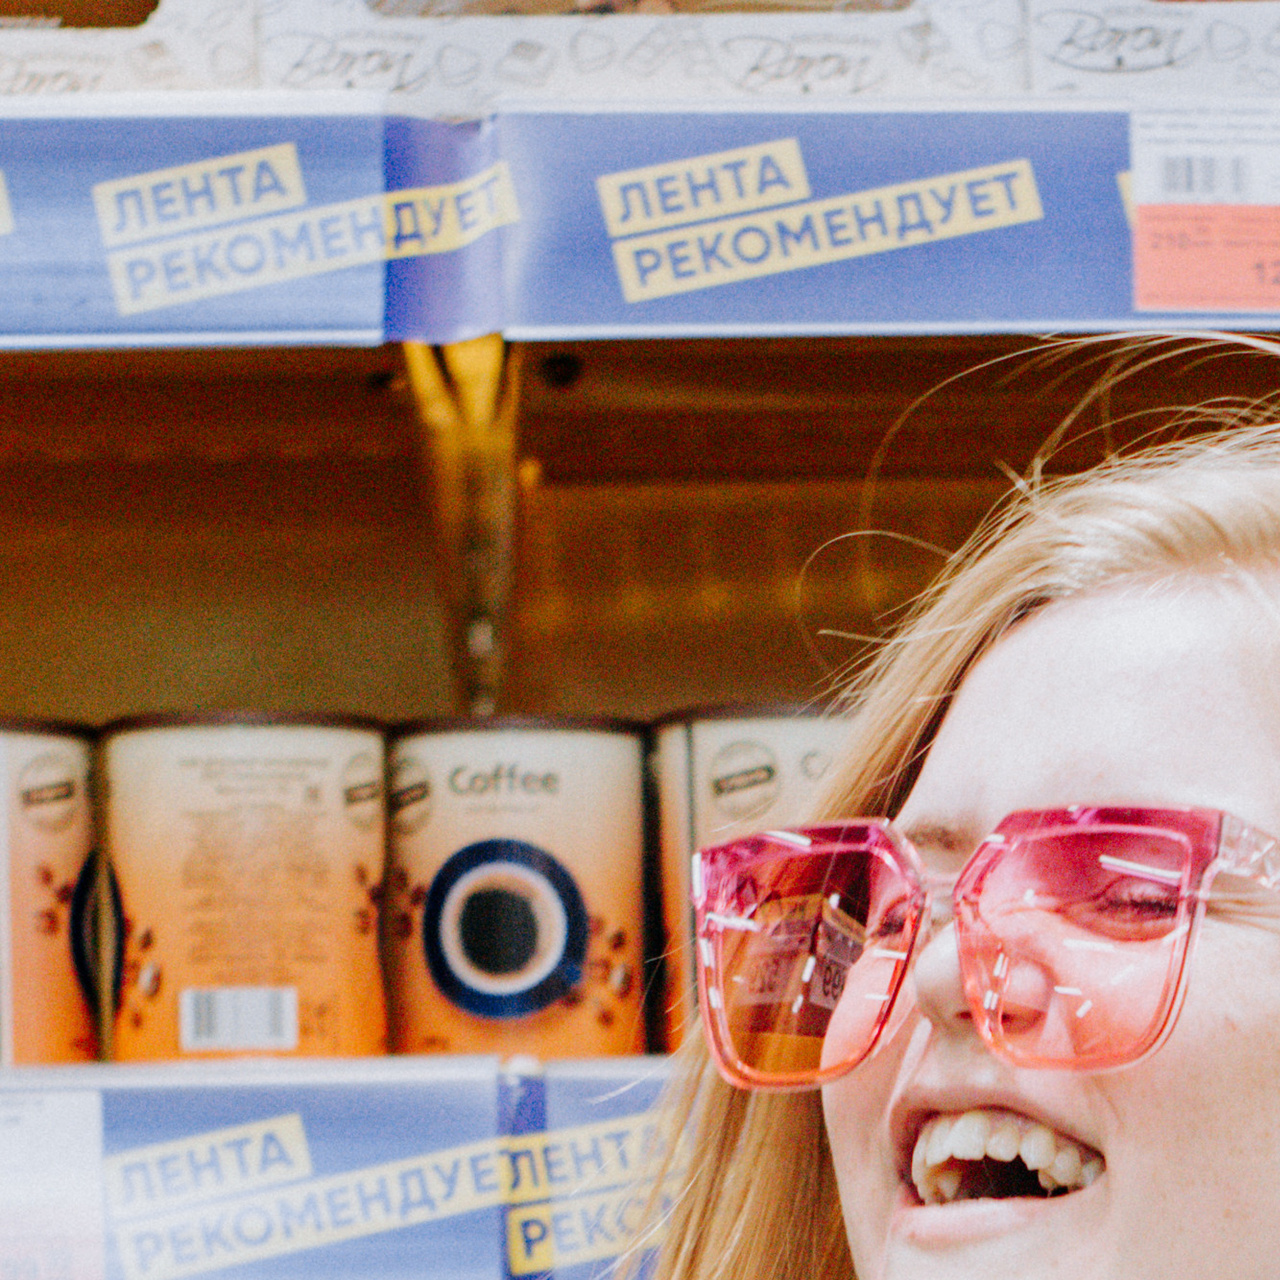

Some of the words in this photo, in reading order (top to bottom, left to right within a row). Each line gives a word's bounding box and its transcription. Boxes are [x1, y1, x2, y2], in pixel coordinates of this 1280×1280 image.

[111, 158, 288, 234] ЛЕНТА
[619, 154, 792, 224] ЛЕНТА
[126, 175, 501, 300] РЕКОМЕНДУЕТ
[634, 172, 1020, 287] РЕКОМЕНДУЕТ
[447, 764, 561, 796] Coffee
[121, 1131, 295, 1203] ЛЕНТА
